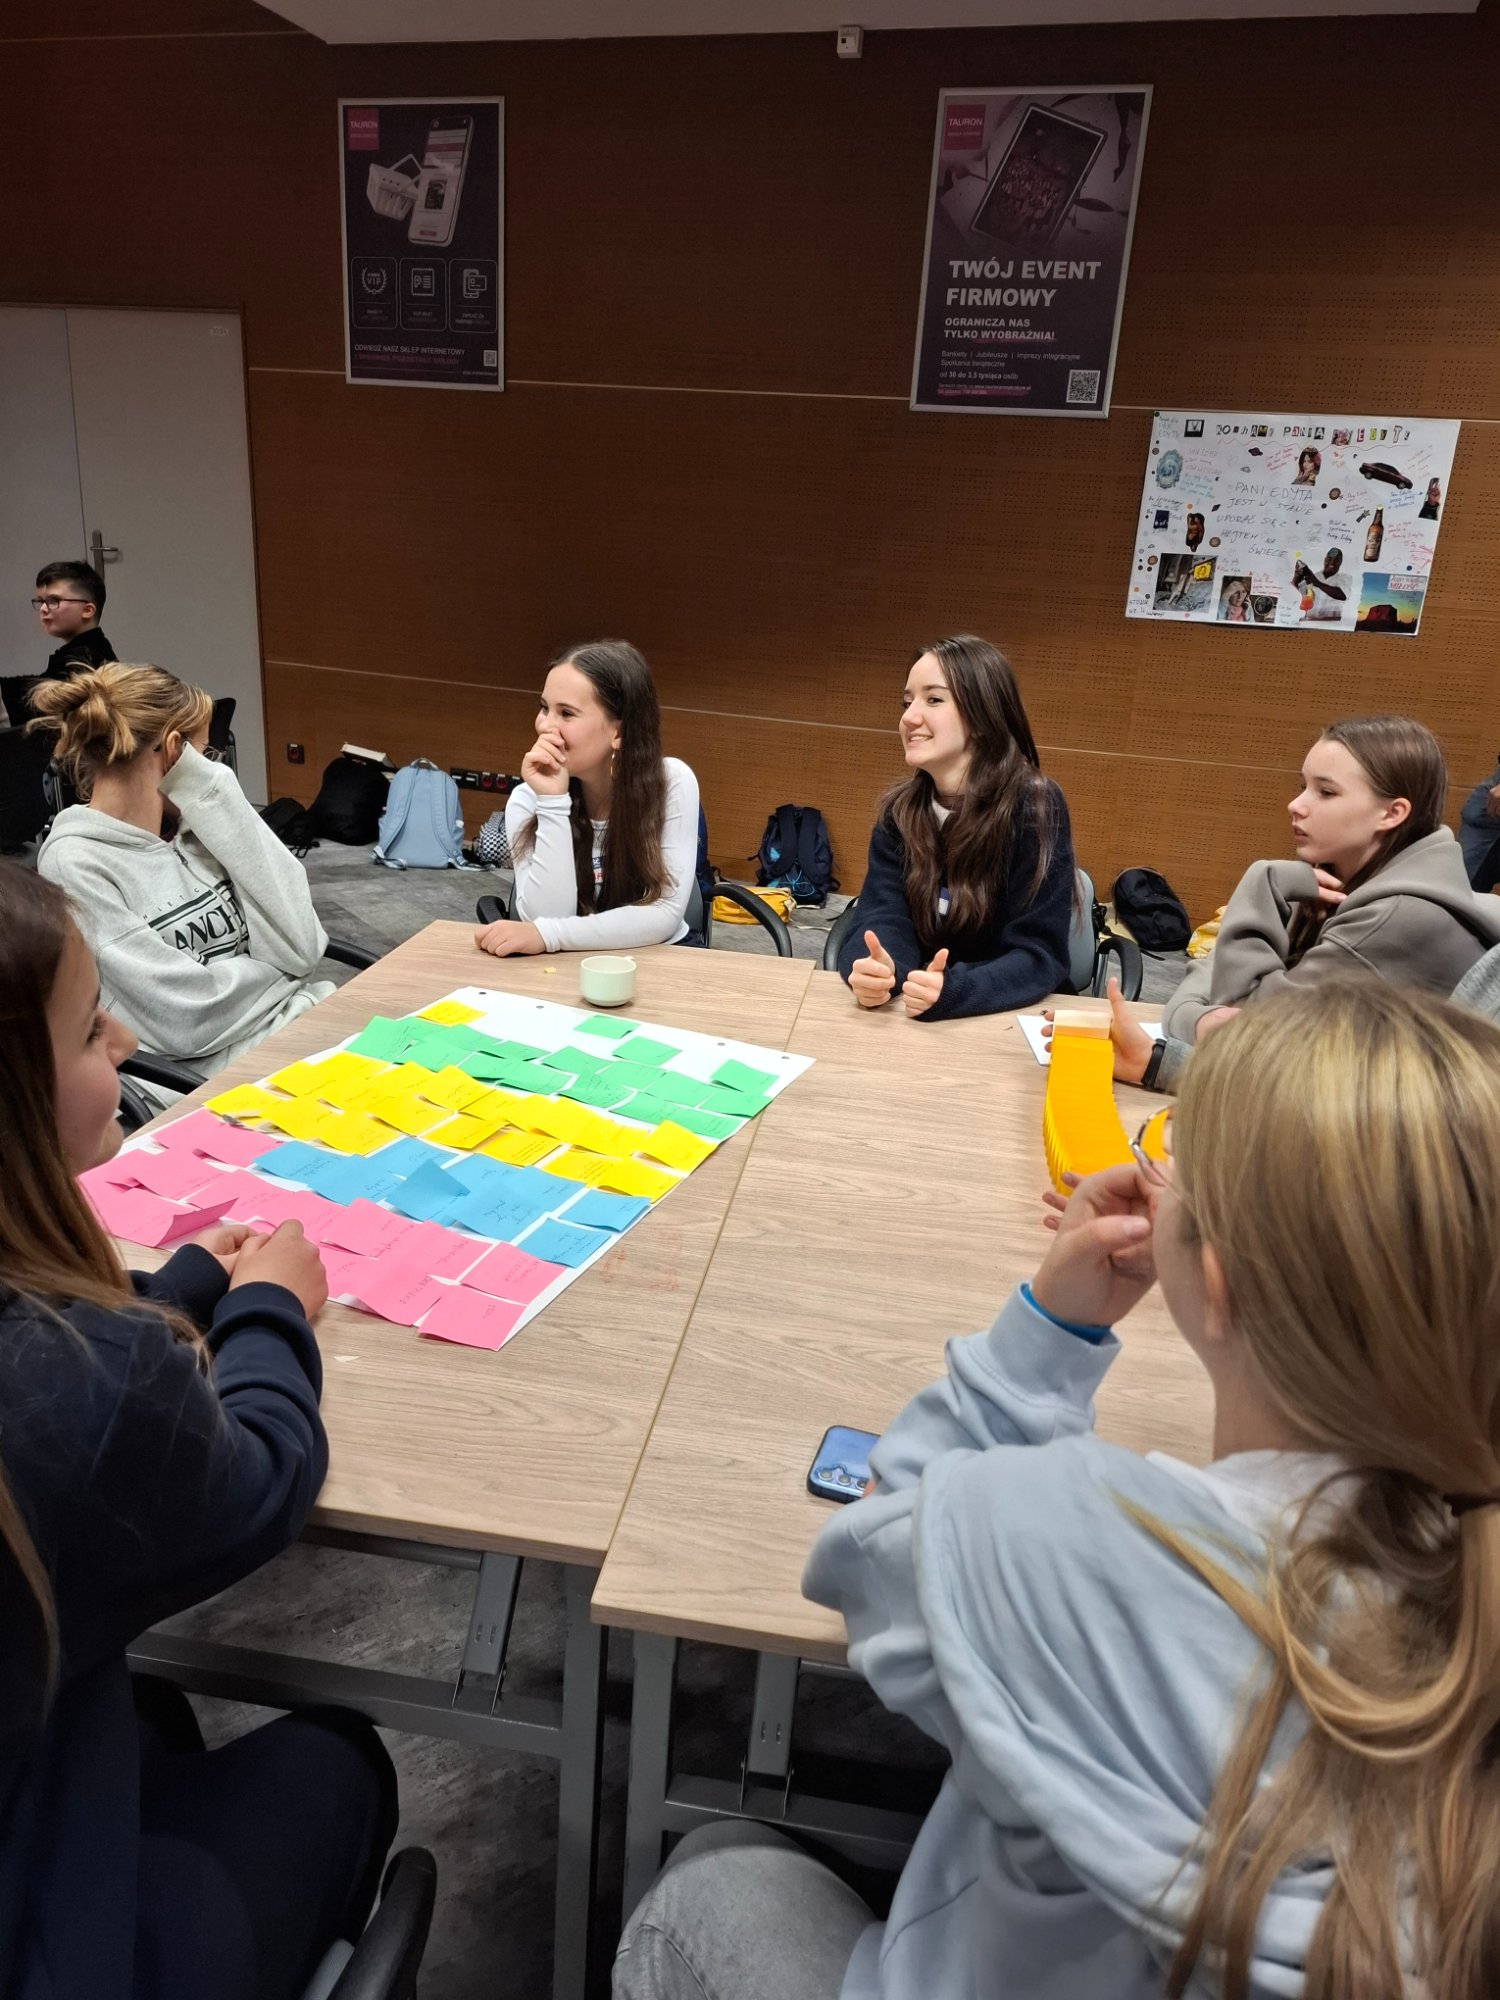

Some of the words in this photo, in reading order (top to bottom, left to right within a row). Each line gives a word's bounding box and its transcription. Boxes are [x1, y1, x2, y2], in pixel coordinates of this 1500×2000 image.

[350, 120, 378, 129] TAURON
[948, 118, 984, 127] TAURON
[949, 256, 1015, 279] TWÓJ
[1021, 260, 1102, 280] EVENT
[367, 276, 382, 286] VIP
[946, 287, 1057, 307] FIRMOWY
[944, 317, 1005, 328] OGRANICZA
[1008, 318, 1031, 328] NAS
[944, 329, 979, 339] TYLKO
[980, 329, 1056, 341] WYOBRAŹNIA!
[383, 345, 399, 353] NASZ
[420, 346, 465, 356] INTERNETOWY
[941, 350, 968, 359] Bankiety
[975, 351, 1008, 359] Jubileusze
[1042, 353, 1081, 361] integracyjne
[941, 358, 971, 368] Spotkania
[948, 371, 957, 379] 30
[958, 371, 967, 379] do
[978, 372, 1002, 380] tysiąca
[1235, 480, 1265, 496] PANI
[1269, 486, 1314, 502] EDYTA
[1226, 497, 1255, 509] JEST
[1274, 503, 1313, 516] STANIE
[1247, 543, 1289, 558] ŚWIECIE
